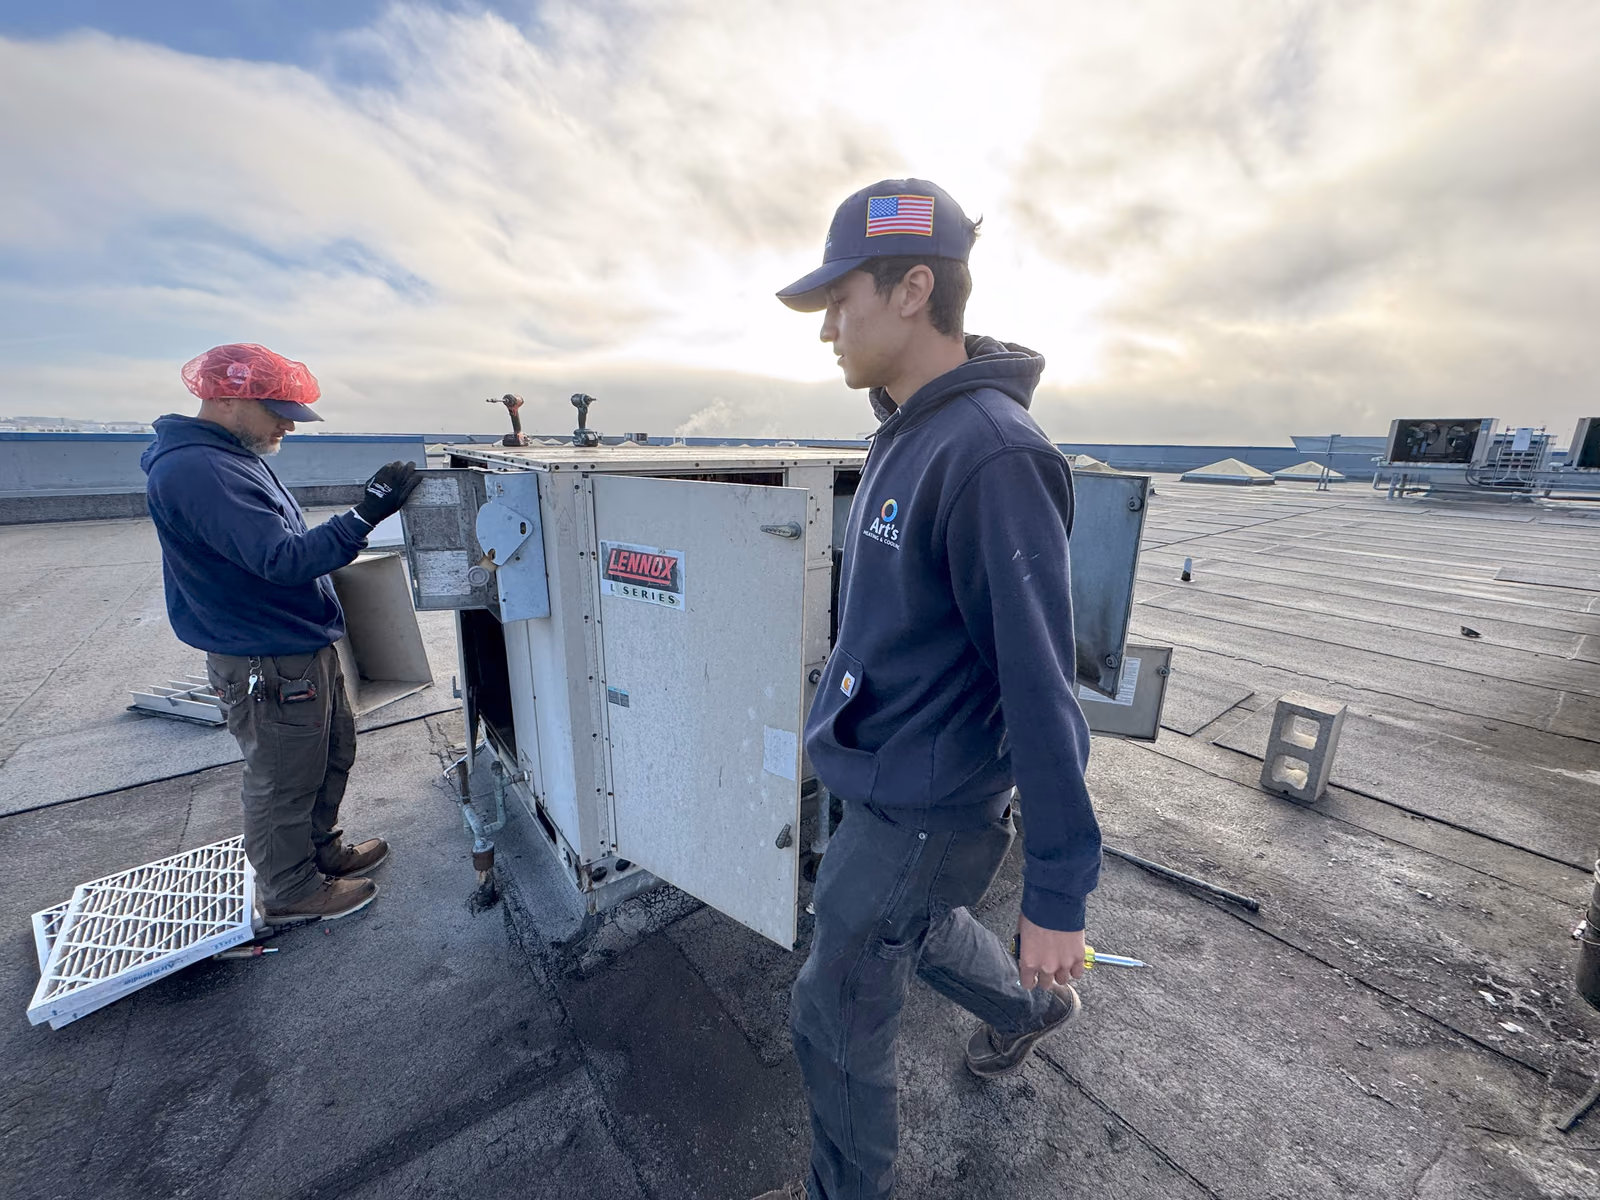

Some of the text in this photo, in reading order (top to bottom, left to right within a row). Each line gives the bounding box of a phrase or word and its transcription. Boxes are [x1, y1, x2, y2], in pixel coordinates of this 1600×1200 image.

[869, 517, 899, 541] Art's
[609, 550, 677, 580] LENNOX
[622, 586, 675, 604] SERIES
